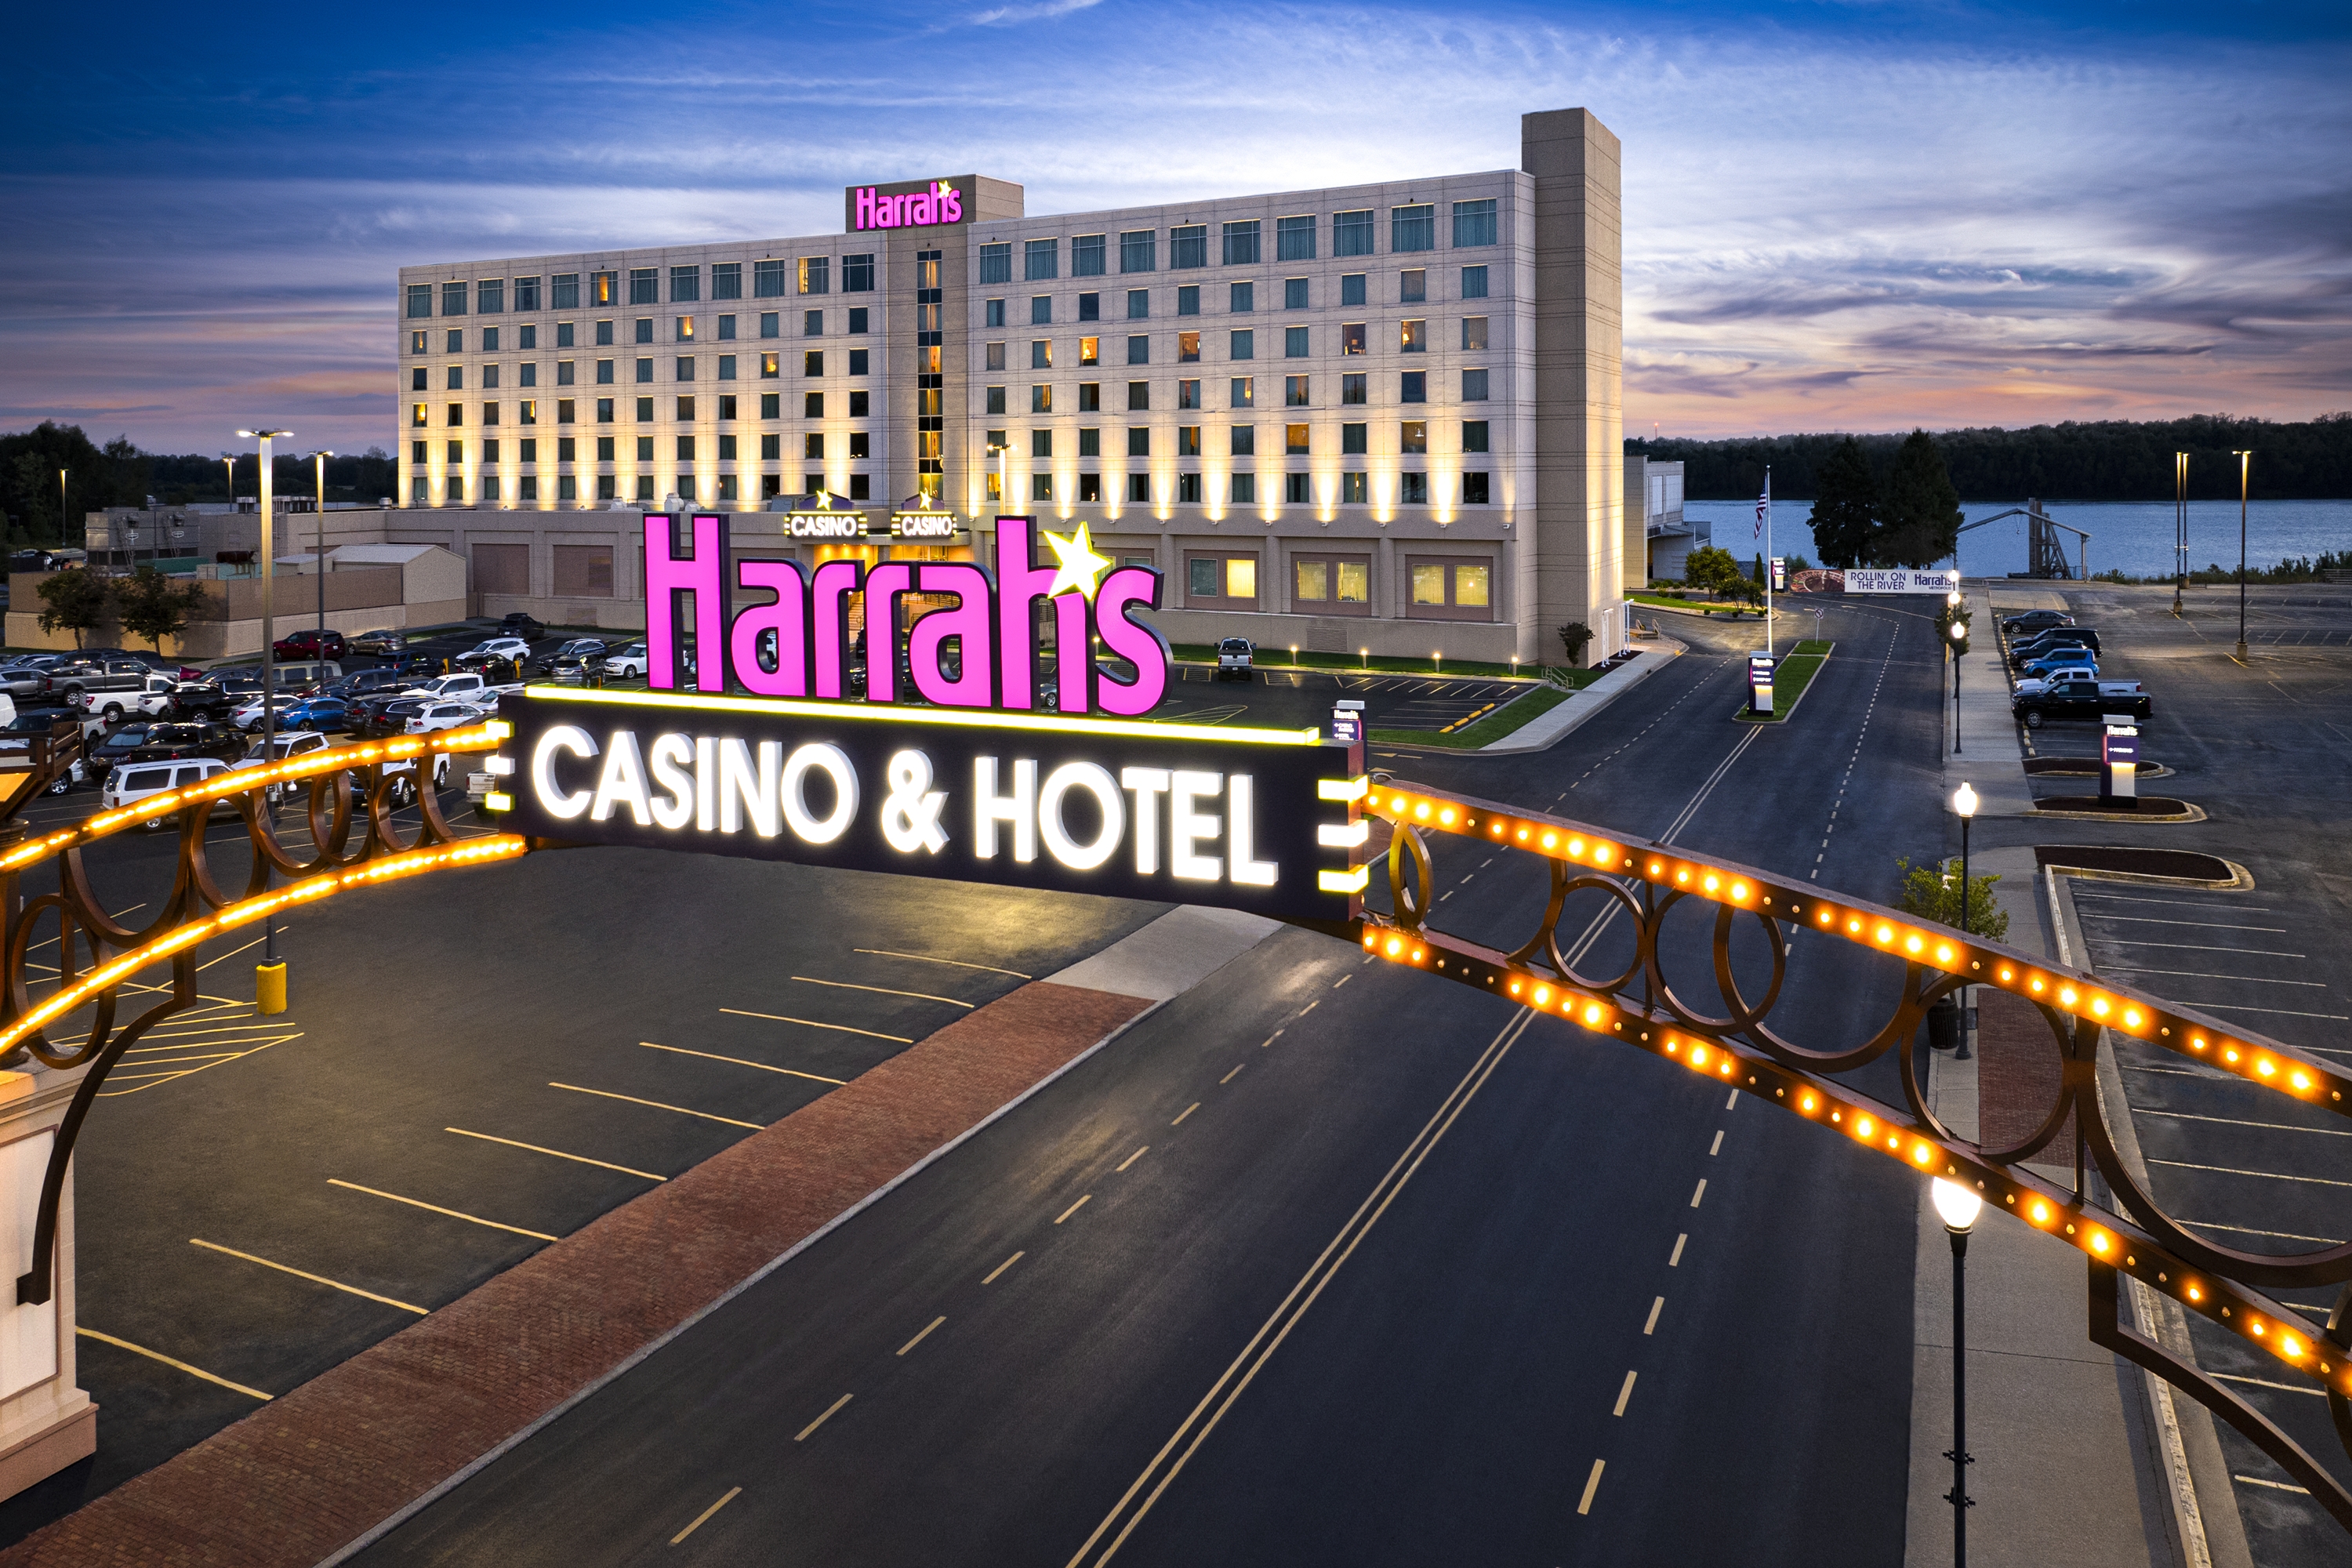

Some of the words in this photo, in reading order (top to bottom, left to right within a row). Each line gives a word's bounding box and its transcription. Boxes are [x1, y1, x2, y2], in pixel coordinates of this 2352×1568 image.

[790, 515, 858, 536] CASINO
[901, 515, 953, 536] CASINO
[1850, 572, 1887, 581] ROLLIN'
[1890, 572, 1906, 581] ON
[1857, 581, 1875, 590] THE
[1877, 581, 1904, 590] RIVER
[532, 724, 860, 845] CASINO
[881, 748, 951, 855] &
[975, 755, 1280, 887] HOTEL
